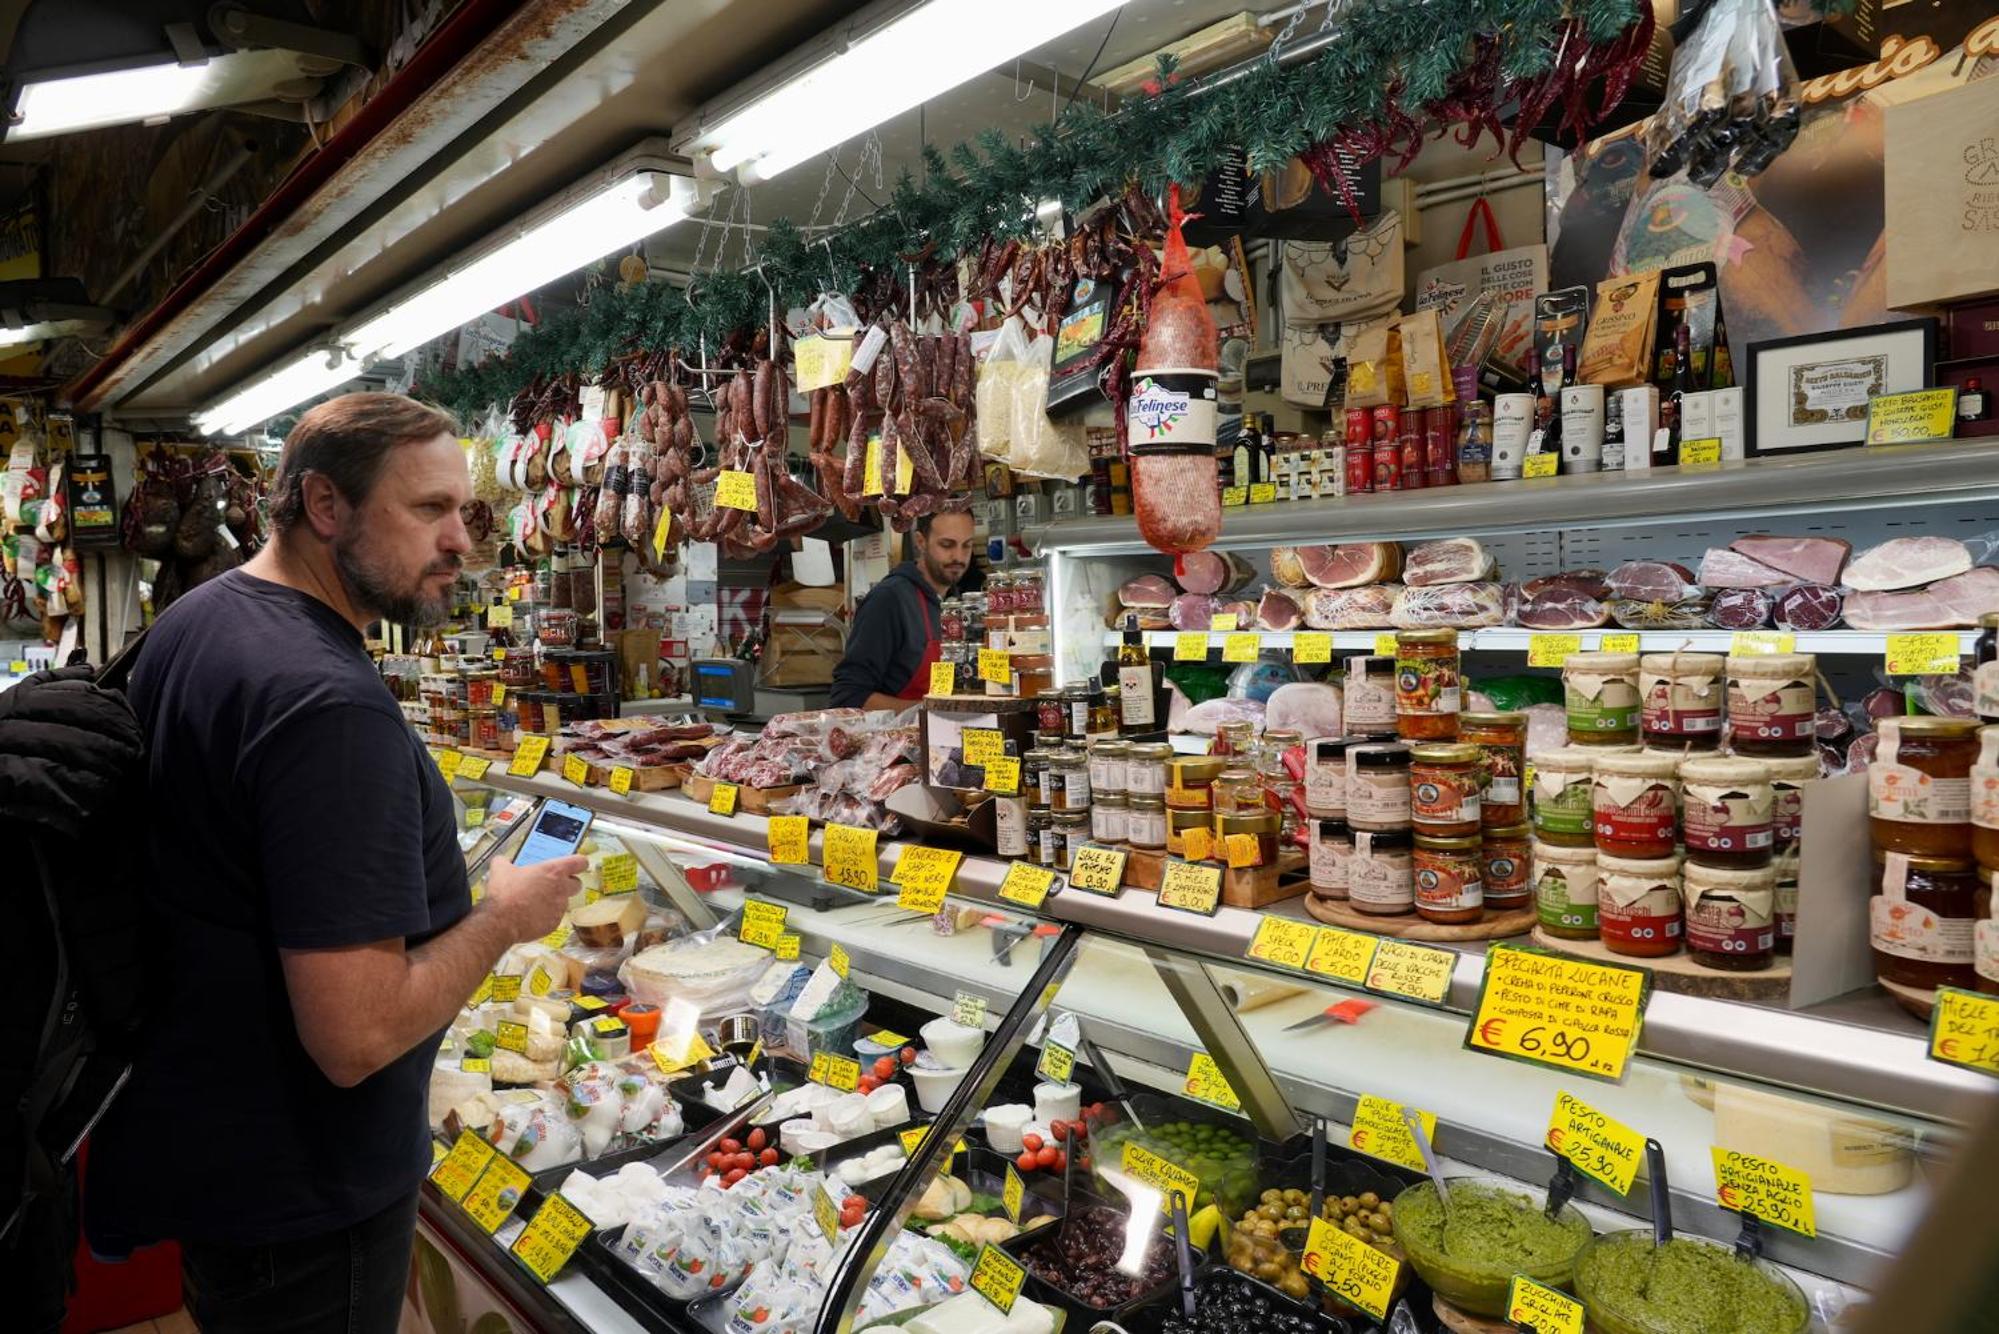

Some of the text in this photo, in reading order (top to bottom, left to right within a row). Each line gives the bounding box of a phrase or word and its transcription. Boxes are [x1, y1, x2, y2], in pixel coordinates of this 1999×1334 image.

[1493, 258, 1533, 274] GUSTO
[1510, 270, 1533, 281] COSE
[1513, 279, 1533, 288] CON
[1137, 399, 1188, 414] Felinese
[1901, 393, 1948, 406] BALSAMICO
[1078, 850, 1101, 862] SALE
[825, 865, 833, 881] €
[1072, 872, 1081, 885] €
[1185, 875, 1211, 886] MIELE
[1161, 892, 1171, 904] €
[1297, 927, 1310, 939] DI
[1253, 944, 1265, 956] €
[1265, 935, 1297, 950] SPECK
[1354, 938, 1366, 949] DI
[1324, 947, 1363, 962] LARDO
[1310, 957, 1321, 971] €
[1375, 957, 1442, 978] DELLE VACCHE
[1370, 972, 1385, 987] €
[1390, 971, 1424, 984] ROSSE
[1567, 968, 1633, 988] LUCANE
[1501, 973, 1634, 1006] CREMA DI PEPERONE CRUSCO
[1501, 989, 1619, 1020] PESTO DI CIME DI RAPA
[1942, 995, 1989, 1020] MIELE
[1498, 1006, 1631, 1038] COMPOSTA DI CIPOLLA ROSSA
[1948, 1020, 1976, 1036] DEL
[1480, 1017, 1507, 1046] €
[1519, 1026, 1590, 1062] 6,90
[1940, 1038, 1960, 1059] €
[1187, 1077, 1200, 1094] €
[1362, 1097, 1391, 1113] OLIVE
[1559, 1094, 1606, 1129] PESTO
[1353, 1130, 1368, 1150] €
[1376, 1132, 1413, 1148] CONDITE
[1567, 1117, 1635, 1162] ARTIGIANALE
[1130, 1147, 1158, 1171] OLIVE
[1547, 1127, 1565, 1152] €
[1566, 1140, 1615, 1176] 25,90
[1727, 1151, 1778, 1176] PESTO
[1719, 1163, 1802, 1196] ARTIGIANALE
[1722, 1175, 1803, 1209] SENZA AGLIO
[1717, 1183, 1740, 1209] €
[1742, 1194, 1792, 1224] 25,90
[516, 1235, 532, 1254] €
[1324, 1229, 1392, 1271] OLIVE NERE
[1303, 1251, 1322, 1275] €
[1323, 1271, 1362, 1298] 1,50
[1329, 1258, 1382, 1292] AL FORNO
[1520, 1282, 1573, 1313] ZUCCHINE
[1512, 1308, 1525, 1321] €
[1520, 1296, 1572, 1325] GRIGLIATE
